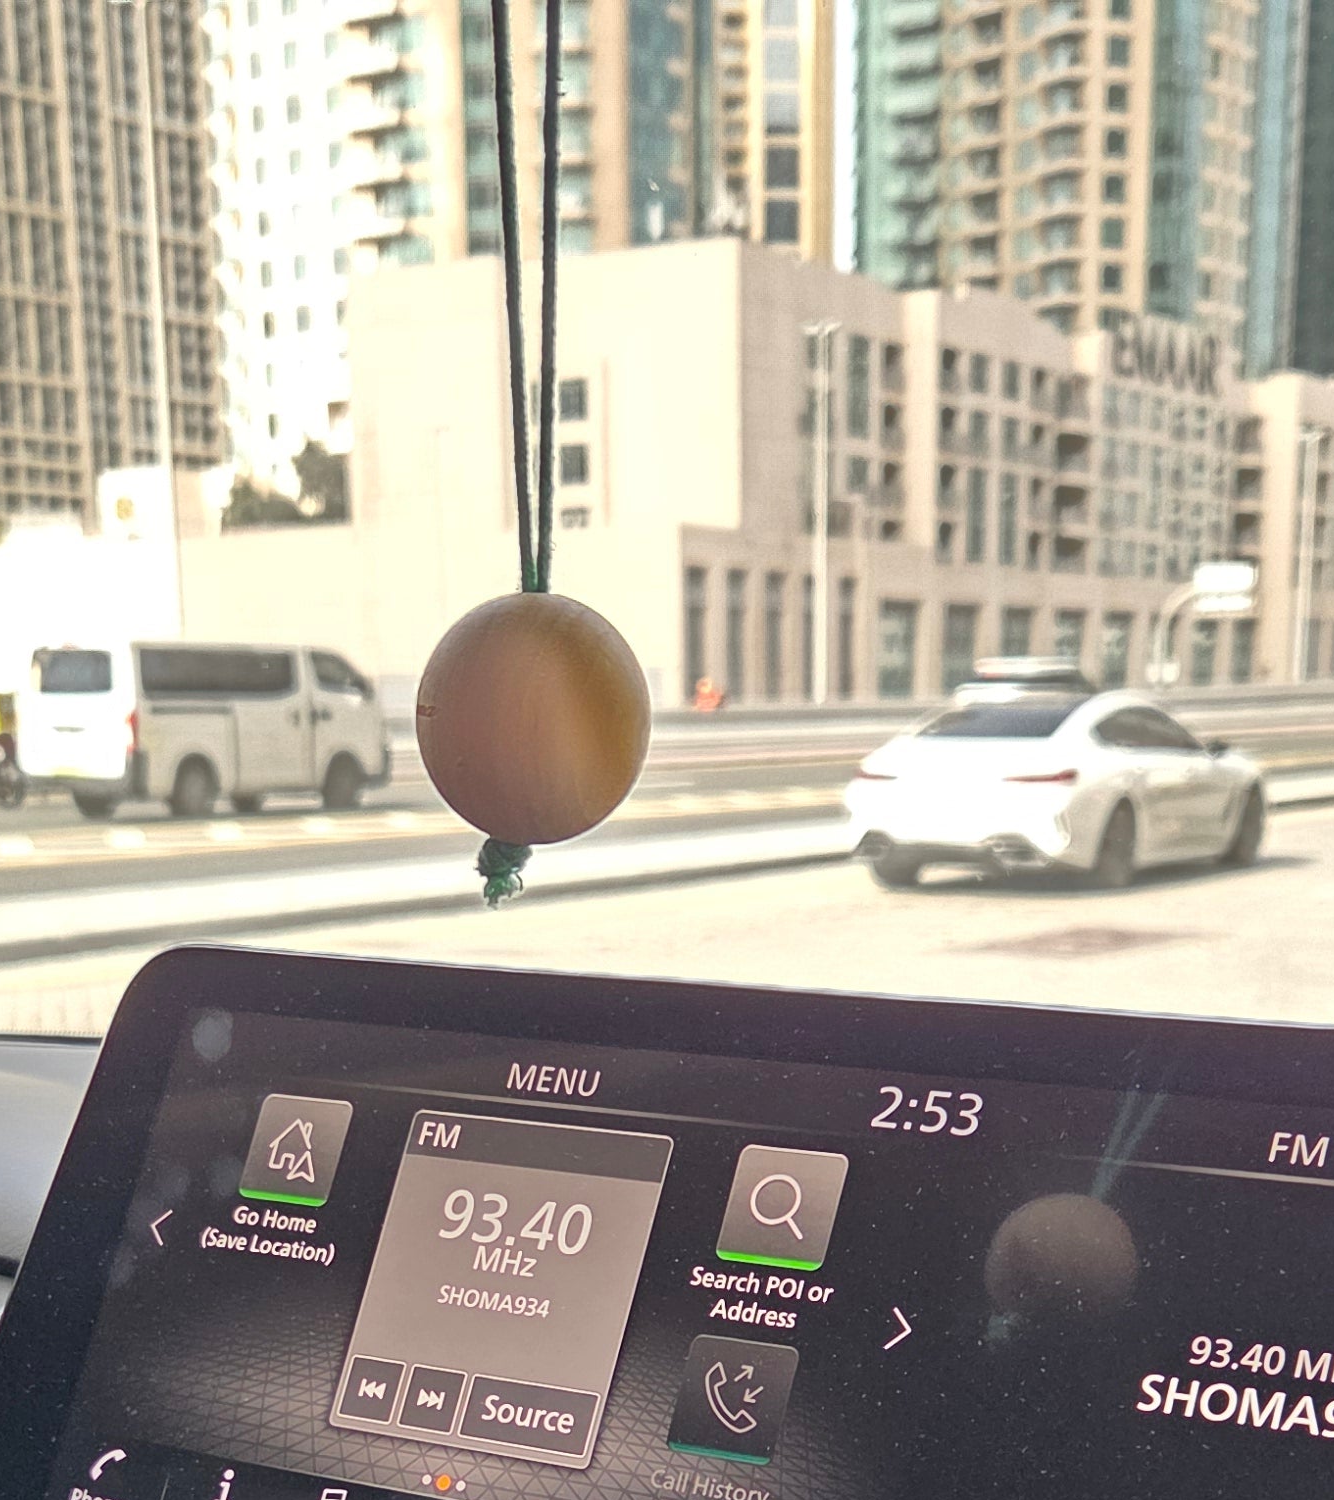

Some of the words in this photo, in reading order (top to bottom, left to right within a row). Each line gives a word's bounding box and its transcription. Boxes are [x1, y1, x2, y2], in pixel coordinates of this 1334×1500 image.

[505, 1061, 602, 1098] MENU
[870, 1085, 984, 1137] 2:53
[418, 1121, 462, 1150] FM
[1268, 1131, 1330, 1168] FM
[233, 1205, 260, 1228] Go
[262, 1208, 318, 1235] Home
[437, 1188, 594, 1257] 93.40
[199, 1227, 247, 1254] (Save
[248, 1231, 336, 1266] Location)
[472, 1246, 537, 1279] MHz
[436, 1284, 551, 1319] SHOMA934
[689, 1265, 761, 1297] Search
[765, 1275, 803, 1301] POI
[805, 1283, 835, 1305] or
[709, 1298, 797, 1331] Address
[1188, 1335, 1287, 1378] 93.40
[480, 1395, 576, 1435] Source
[649, 1468, 689, 1494] Call
